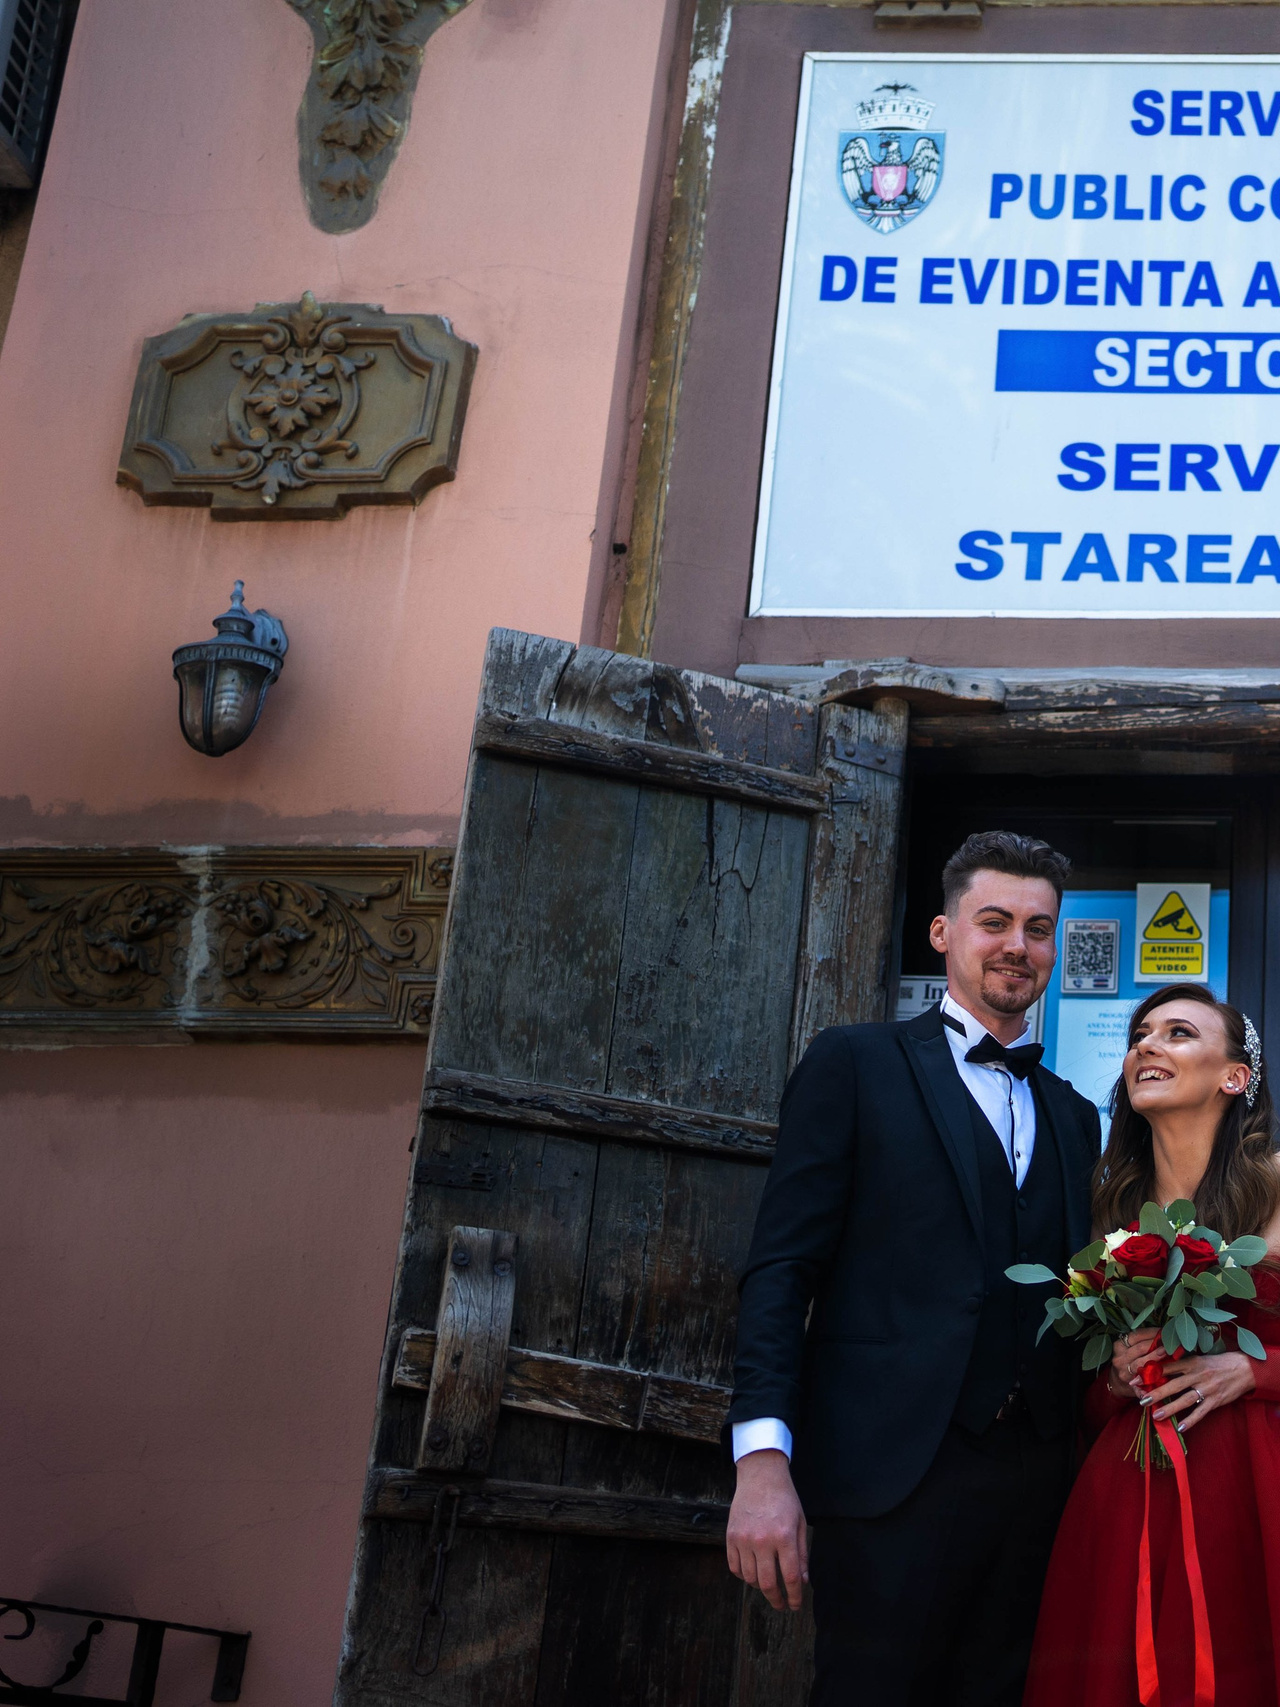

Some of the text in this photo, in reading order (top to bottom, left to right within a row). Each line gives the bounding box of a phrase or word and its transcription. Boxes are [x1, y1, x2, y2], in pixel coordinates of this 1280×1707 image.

[988, 173, 1206, 222] PUBLIC
[819, 255, 898, 304] DE
[919, 257, 1224, 308] EVIDENTA
